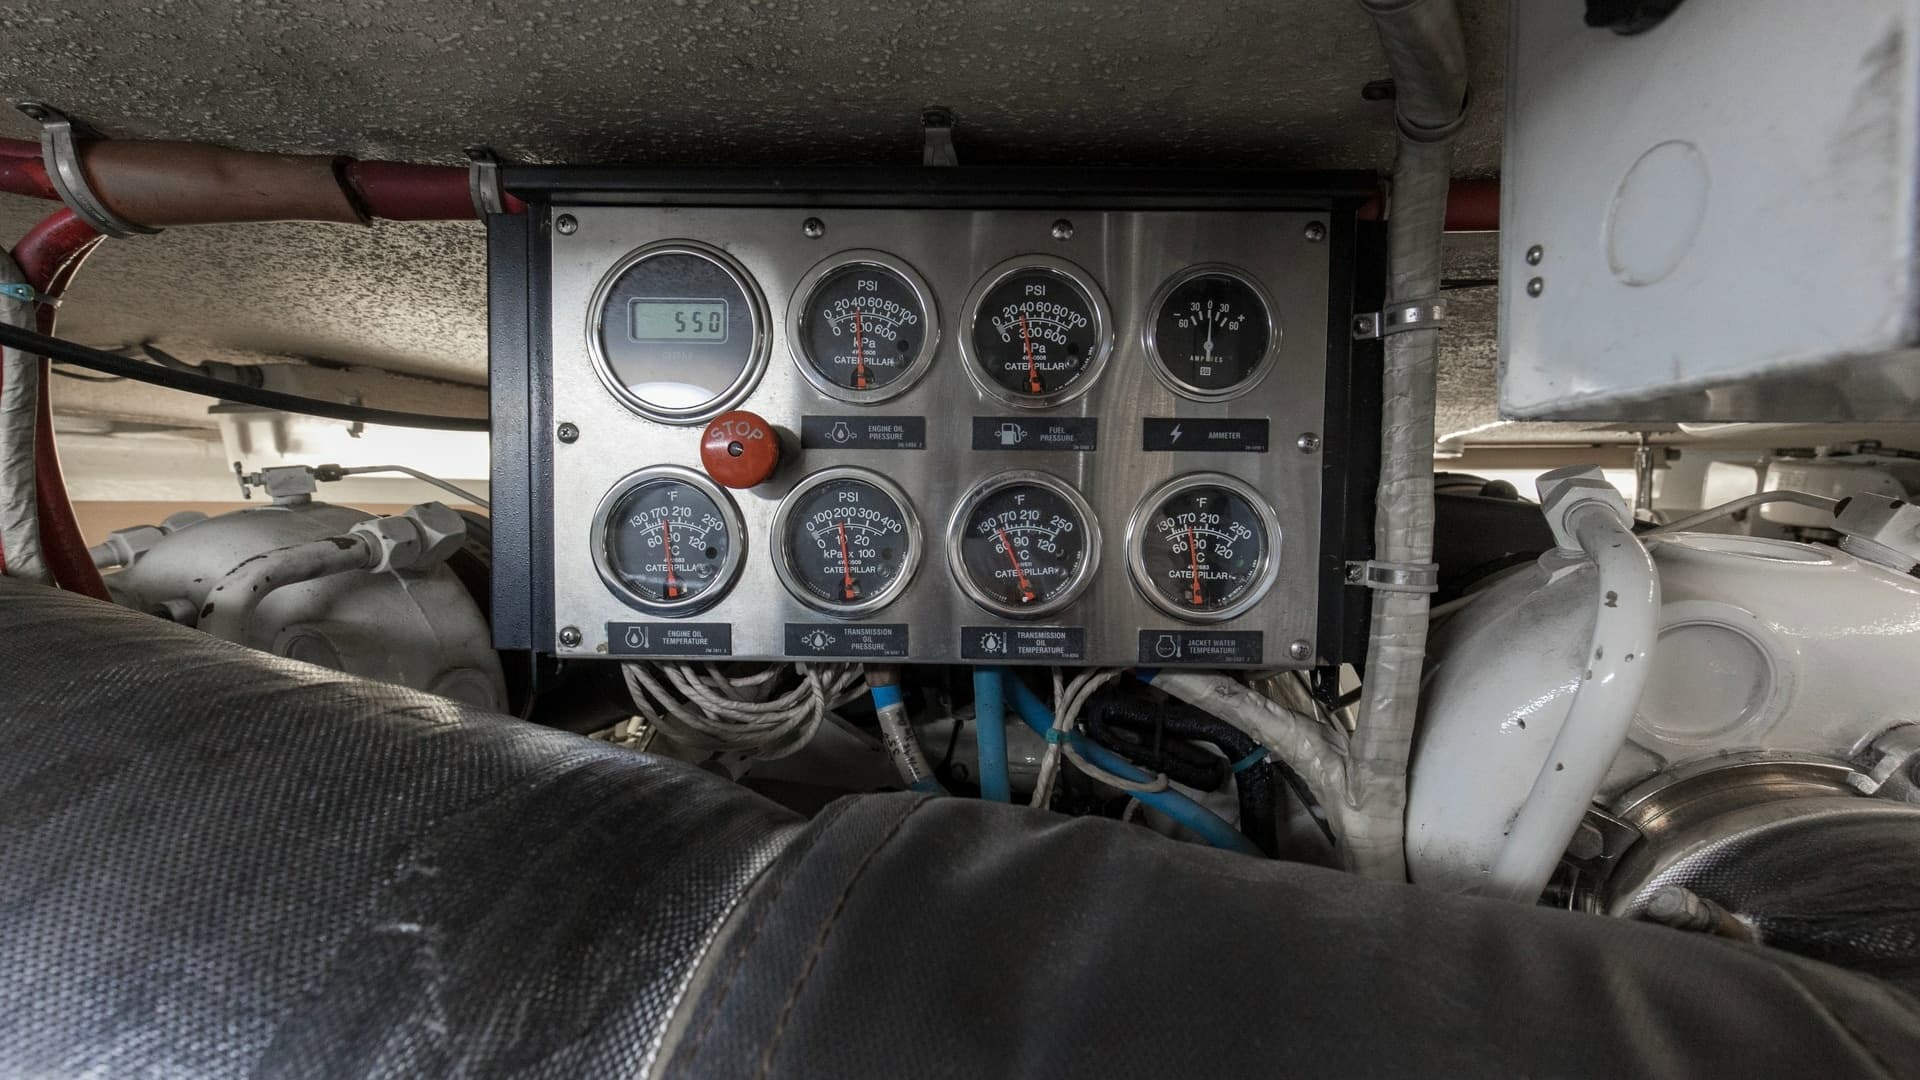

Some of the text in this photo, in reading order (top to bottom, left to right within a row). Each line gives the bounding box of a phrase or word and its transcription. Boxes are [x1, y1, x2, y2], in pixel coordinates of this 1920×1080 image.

[858, 280, 878, 292] PSI
[1026, 284, 1046, 296] PSI
[824, 296, 918, 325] 0 20 40 60 80 100
[992, 302, 1087, 328] 0 20 40 60 80 100
[1178, 300, 1239, 330] 60 30 0 30 60
[675, 312, 720, 333] 550
[832, 326, 841, 336] 0
[874, 324, 896, 340] 600
[1002, 328, 1066, 344] 0 300 600
[834, 356, 895, 366] CATEPILLAR
[1004, 362, 1064, 370] CATEPILLAR
[710, 420, 764, 440] STOP
[1208, 432, 1240, 440] AMMETER
[839, 492, 858, 502] PSI
[630, 506, 723, 531] 130 170 210 250
[806, 507, 902, 534] 0 100 200 300 400
[977, 510, 1072, 534] 130 170 210 250
[1156, 512, 1252, 540] 130 170 210 250
[648, 535, 662, 548] 60
[688, 536, 706, 551] 120
[817, 539, 826, 549] 0
[854, 534, 870, 546] 20
[1014, 536, 1029, 547] 90
[1038, 538, 1056, 553] 120
[824, 550, 842, 558] kPa
[858, 549, 876, 558] 100
[1172, 541, 1188, 554] 60
[1214, 544, 1233, 560] 120
[1168, 570, 1228, 580] CATEPILLAR
